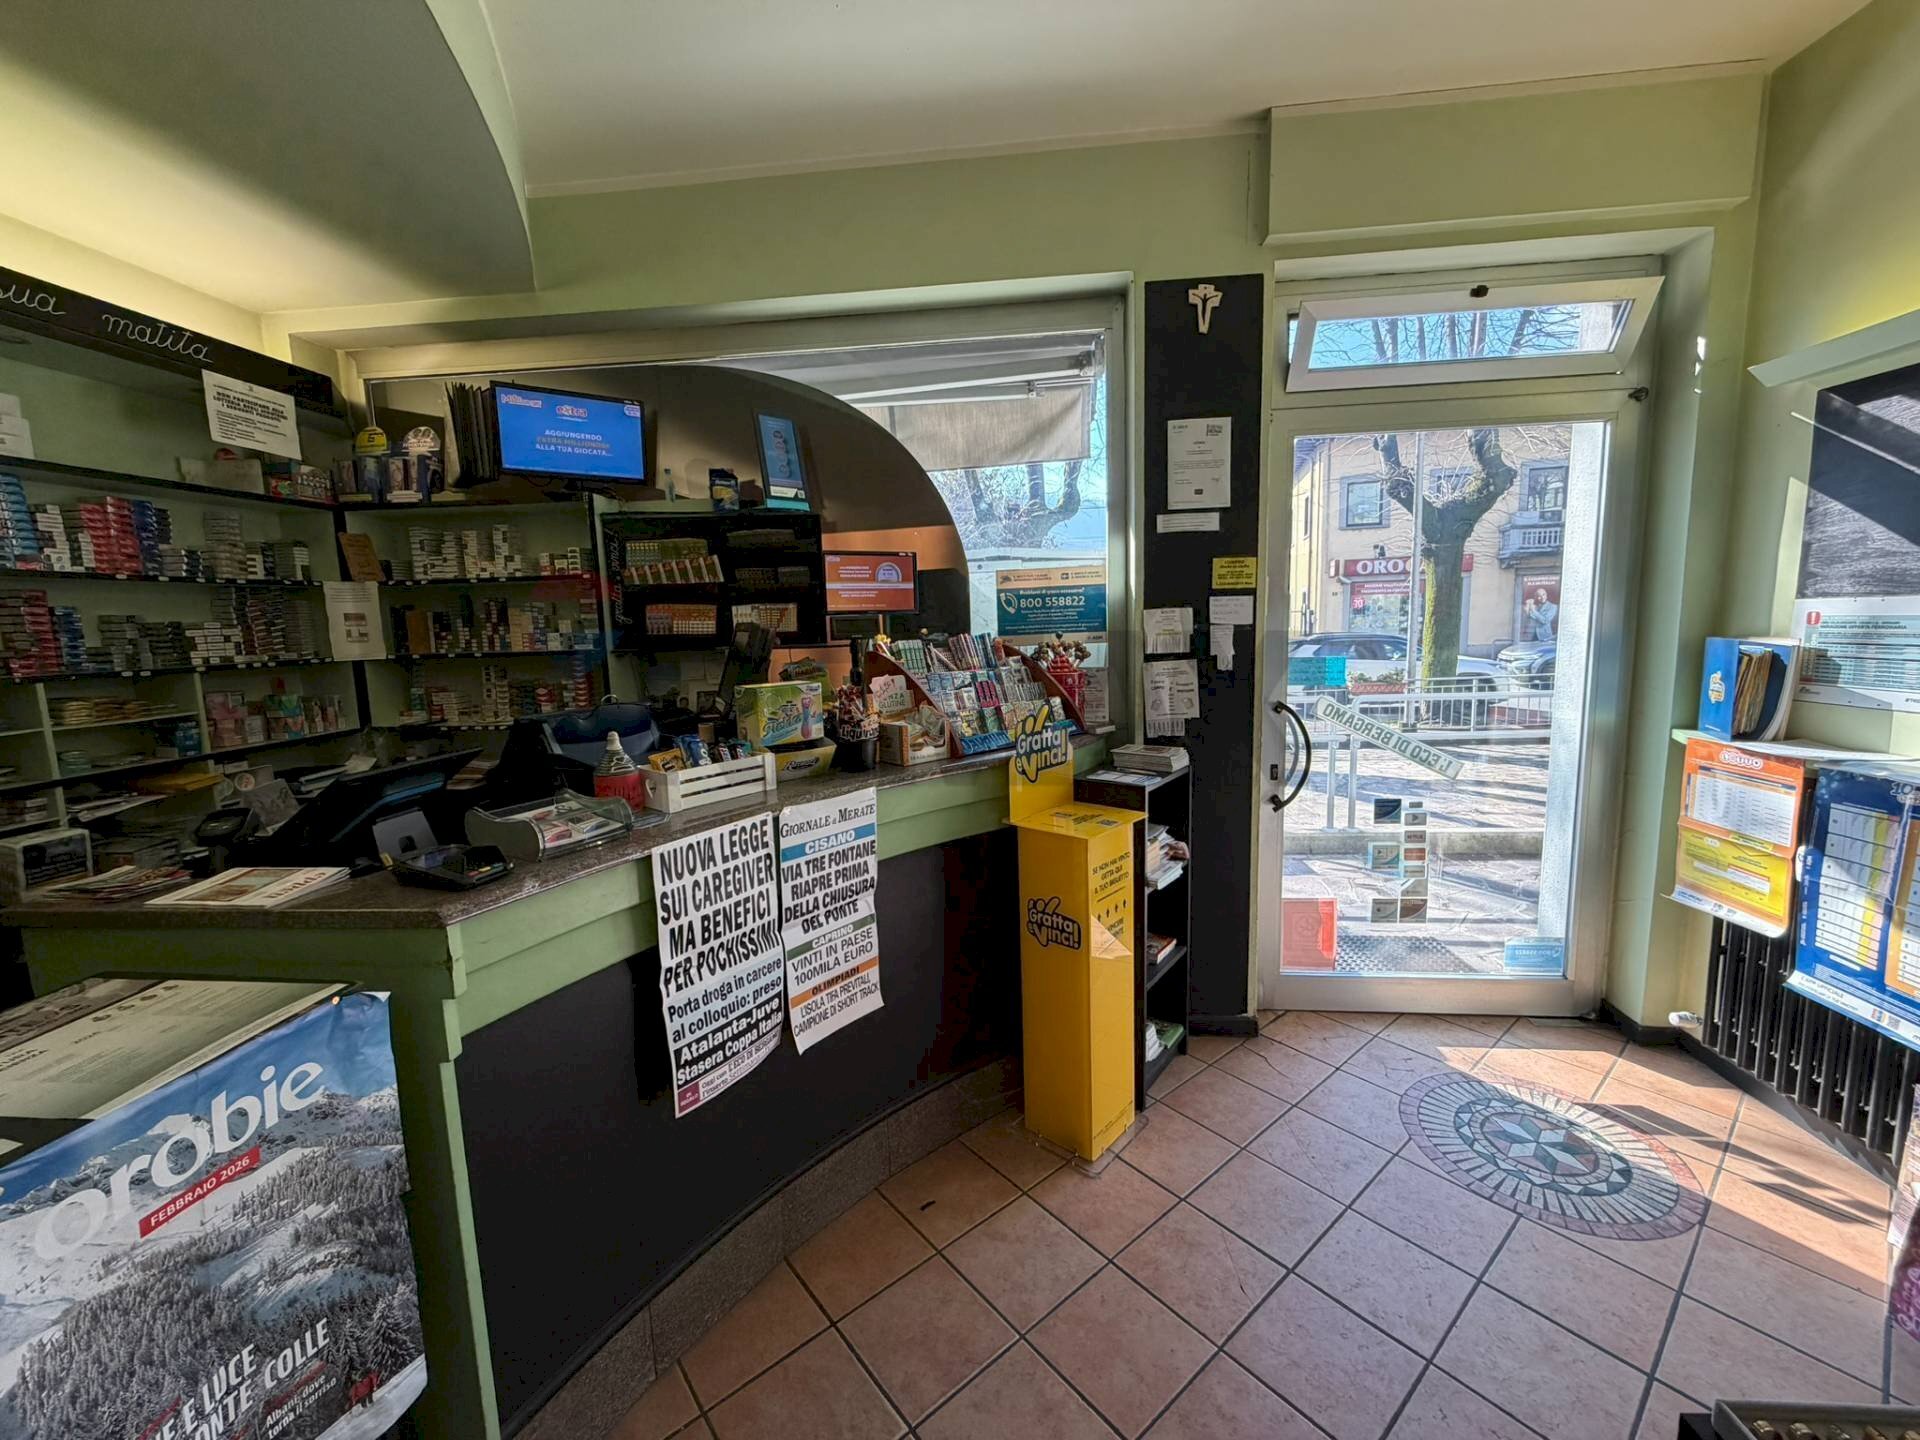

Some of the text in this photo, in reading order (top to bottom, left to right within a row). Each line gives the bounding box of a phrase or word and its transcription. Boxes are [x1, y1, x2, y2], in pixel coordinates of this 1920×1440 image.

[535, 443, 556, 452] ALLA
[556, 445, 573, 454] TUA
[544, 429, 602, 441] AGGIUNGENDO
[1020, 596, 1086, 608] 800 558822
[1017, 728, 1062, 754] Gratta
[780, 815, 831, 838] GIORNALE
[838, 804, 875, 823] MERATE
[805, 830, 855, 854] CISANO
[659, 819, 770, 886] NUOVA LEGGE
[782, 840, 876, 884] VIA TRE FONTANE
[660, 852, 774, 925] SUI CAREGIVER
[784, 876, 875, 924] DELLA CHIUSURA
[791, 860, 870, 901] RIAPRE PRIMA
[669, 887, 771, 960] MA BENEFICI
[801, 898, 859, 934] DEL PONTE
[812, 924, 854, 949] CAPRINO
[1030, 908, 1073, 933] Gratta
[663, 918, 780, 998] PER POCHISSIMI
[791, 927, 873, 973] VINTI IN PAESE
[794, 941, 874, 986] 100MILA EURO
[668, 958, 782, 1023] Porta droga in carcere
[812, 966, 859, 996] OLIMPIADI
[672, 975, 782, 1043] al colloquio: preso
[680, 998, 779, 1065] Atalanta-Juve
[793, 982, 880, 1037] CAMPIONE DI SHORT TRACK
[677, 1054, 724, 1086] Stasera
[725, 1029, 758, 1057] Coppa
[759, 1011, 782, 1036] Italia
[34, 1062, 325, 1259] orobie
[150, 1155, 251, 1228] FEBBRAIO 2026
[264, 1317, 330, 1390] COLLE
[181, 1397, 198, 1435] E
[202, 1343, 257, 1416] LUCE
[268, 1377, 337, 1440] torna il sorriso
[302, 1374, 326, 1397] dove
